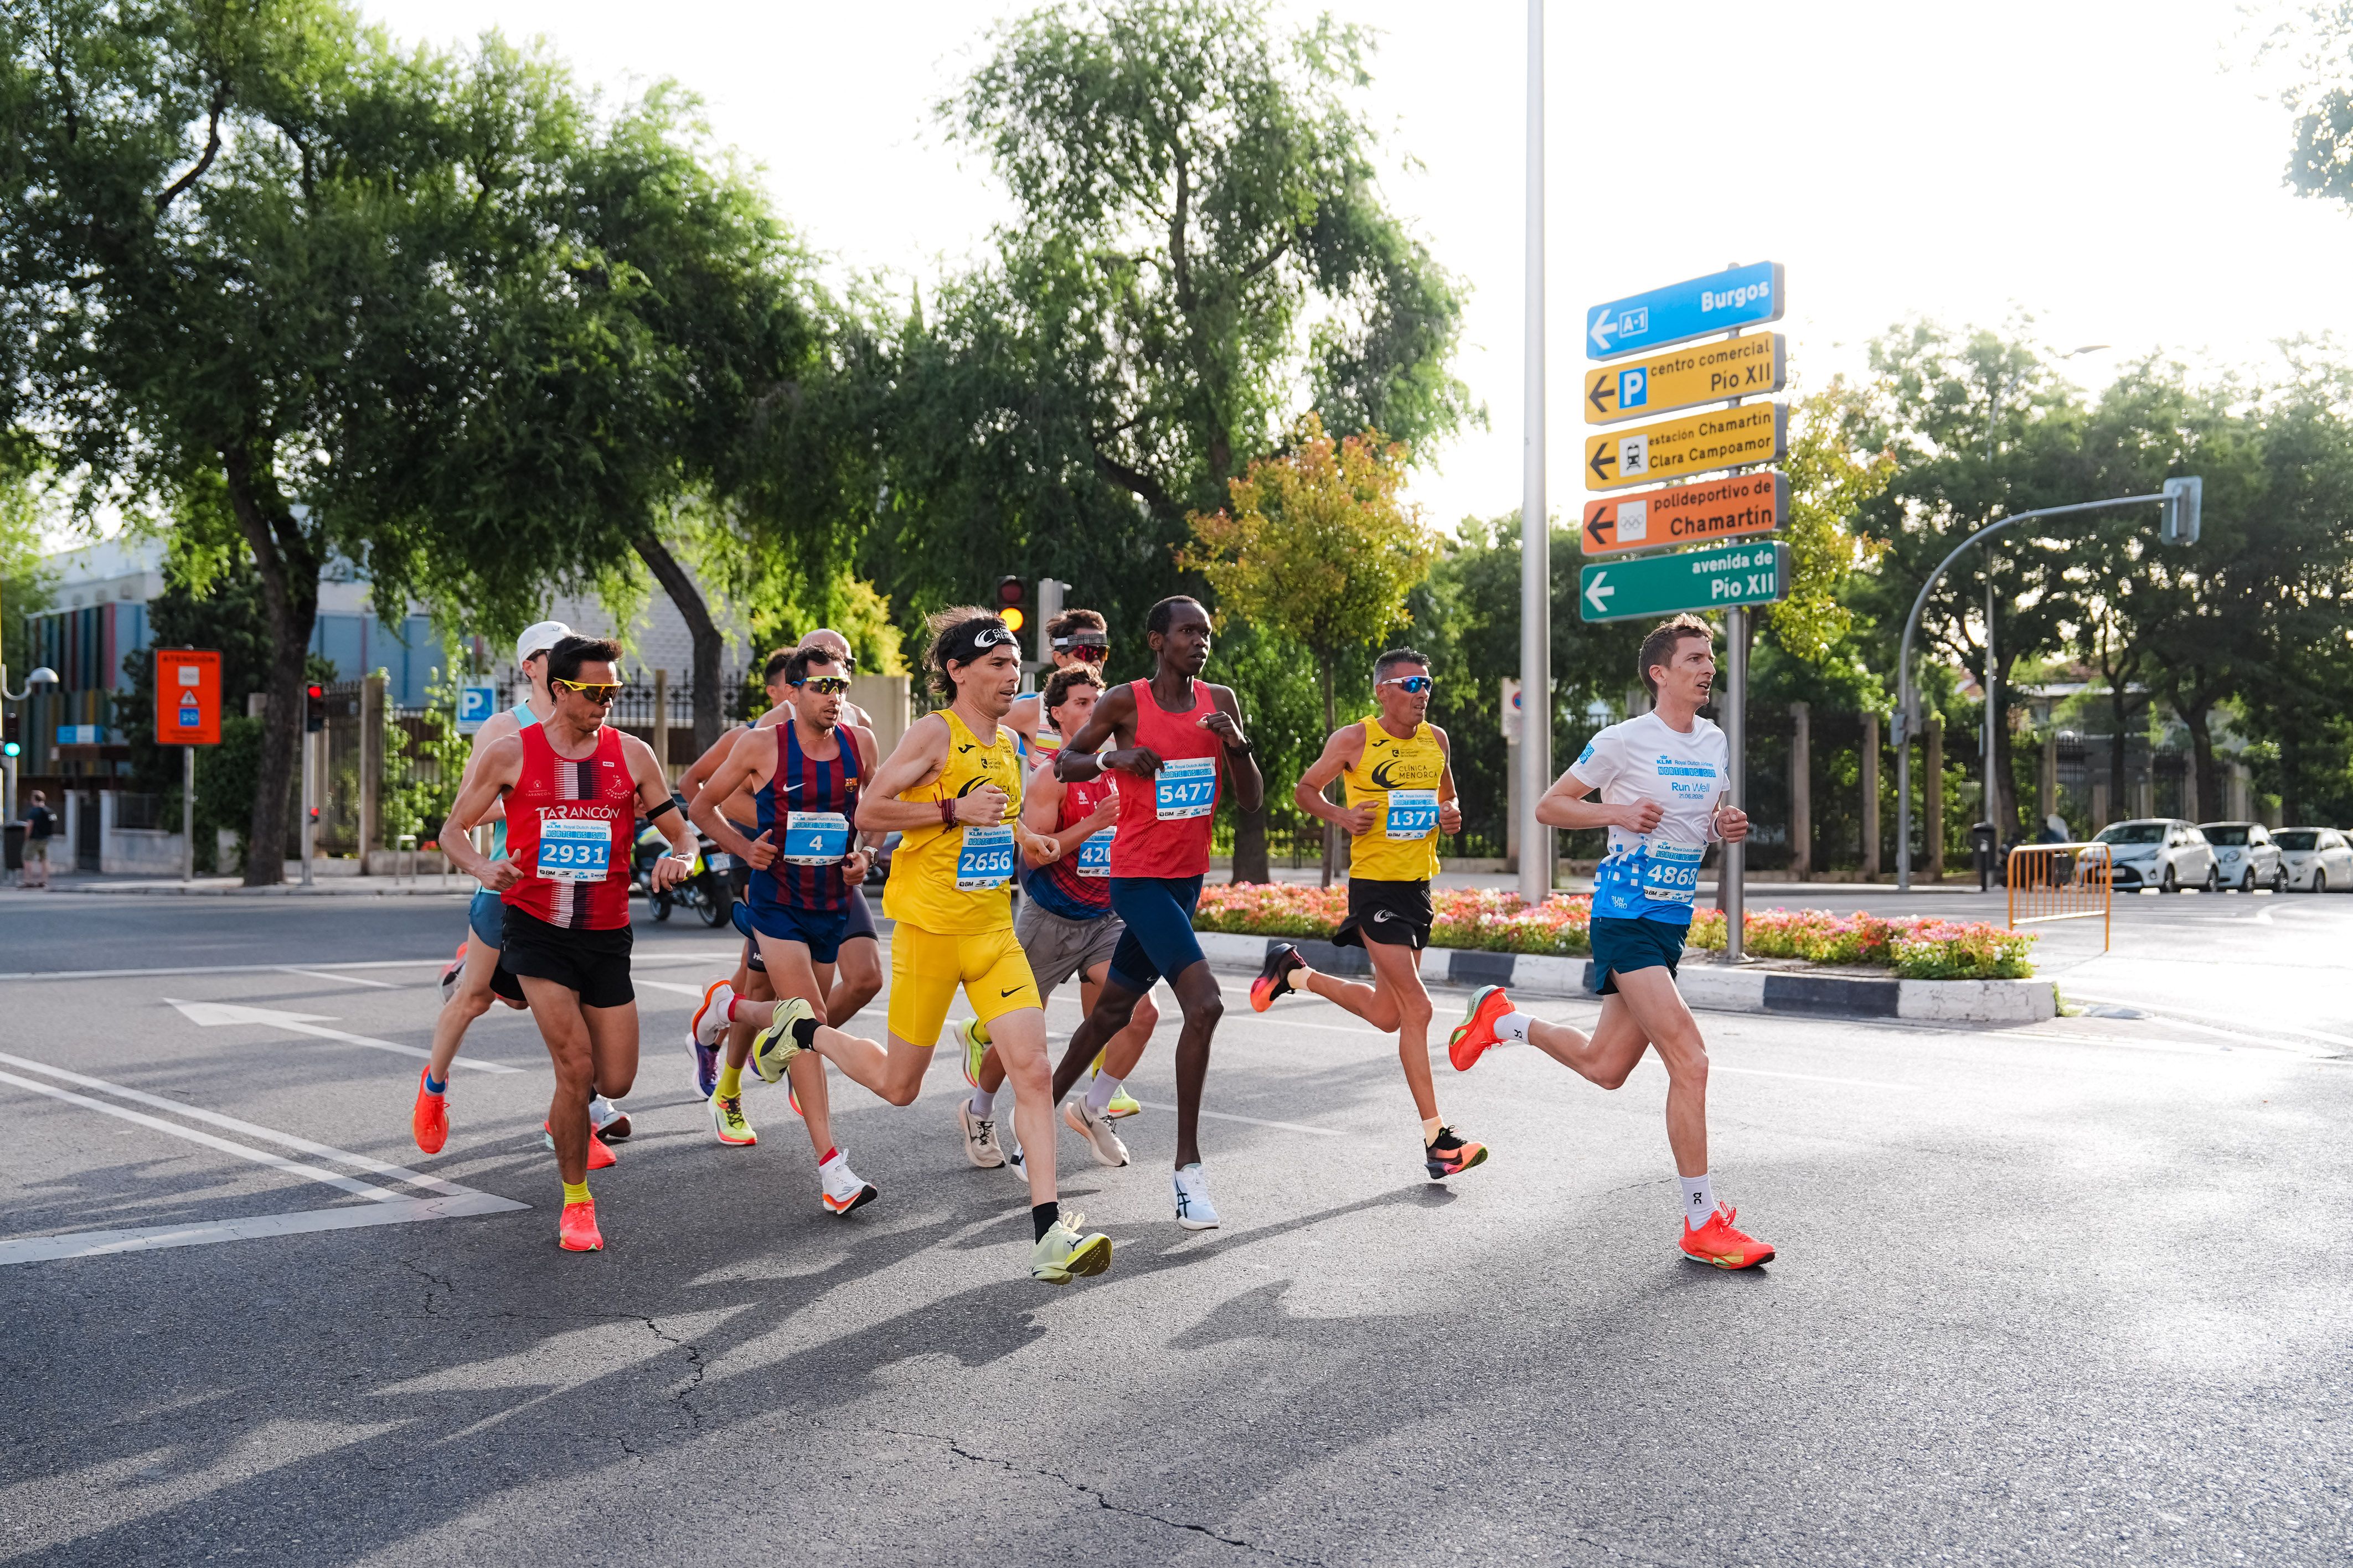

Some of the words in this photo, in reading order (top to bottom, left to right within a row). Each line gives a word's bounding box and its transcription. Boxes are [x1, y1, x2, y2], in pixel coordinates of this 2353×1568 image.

[1623, 312, 1646, 332] A-1
[1701, 281, 1770, 312] Burgos
[1652, 356, 1694, 376] centro
[1699, 339, 1770, 366] comercial
[1624, 371, 1644, 406] P
[1711, 369, 1739, 392] Pío
[1746, 363, 1771, 384] XII
[1649, 428, 1694, 447] estación
[1699, 411, 1771, 436] Chamartín
[1650, 454, 1684, 468] Clara
[1690, 437, 1771, 461] Campoamor
[1654, 484, 1749, 512] polideportivo
[1754, 480, 1771, 494] de
[1670, 505, 1772, 536] Chamartín
[1692, 553, 1750, 575] avenida
[1754, 550, 1773, 566] de
[1711, 576, 1743, 599] Pío
[1746, 573, 1774, 596] XII
[462, 690, 483, 718] P
[1160, 770, 1183, 778] NORTE
[1658, 767, 1685, 775] NORTE
[1689, 768, 1699, 776] VS
[1704, 769, 1716, 777] SUR
[1160, 782, 1214, 803] 5477
[1672, 782, 1690, 791] Run
[1692, 783, 1710, 792] Well
[535, 805, 620, 820] TARANCÓN
[1391, 811, 1437, 826] 1371
[543, 844, 605, 864] 2931
[809, 835, 823, 851] 4
[962, 851, 1010, 871] 2656
[1656, 851, 1679, 860] NORTE
[1648, 865, 1697, 885] 4868
